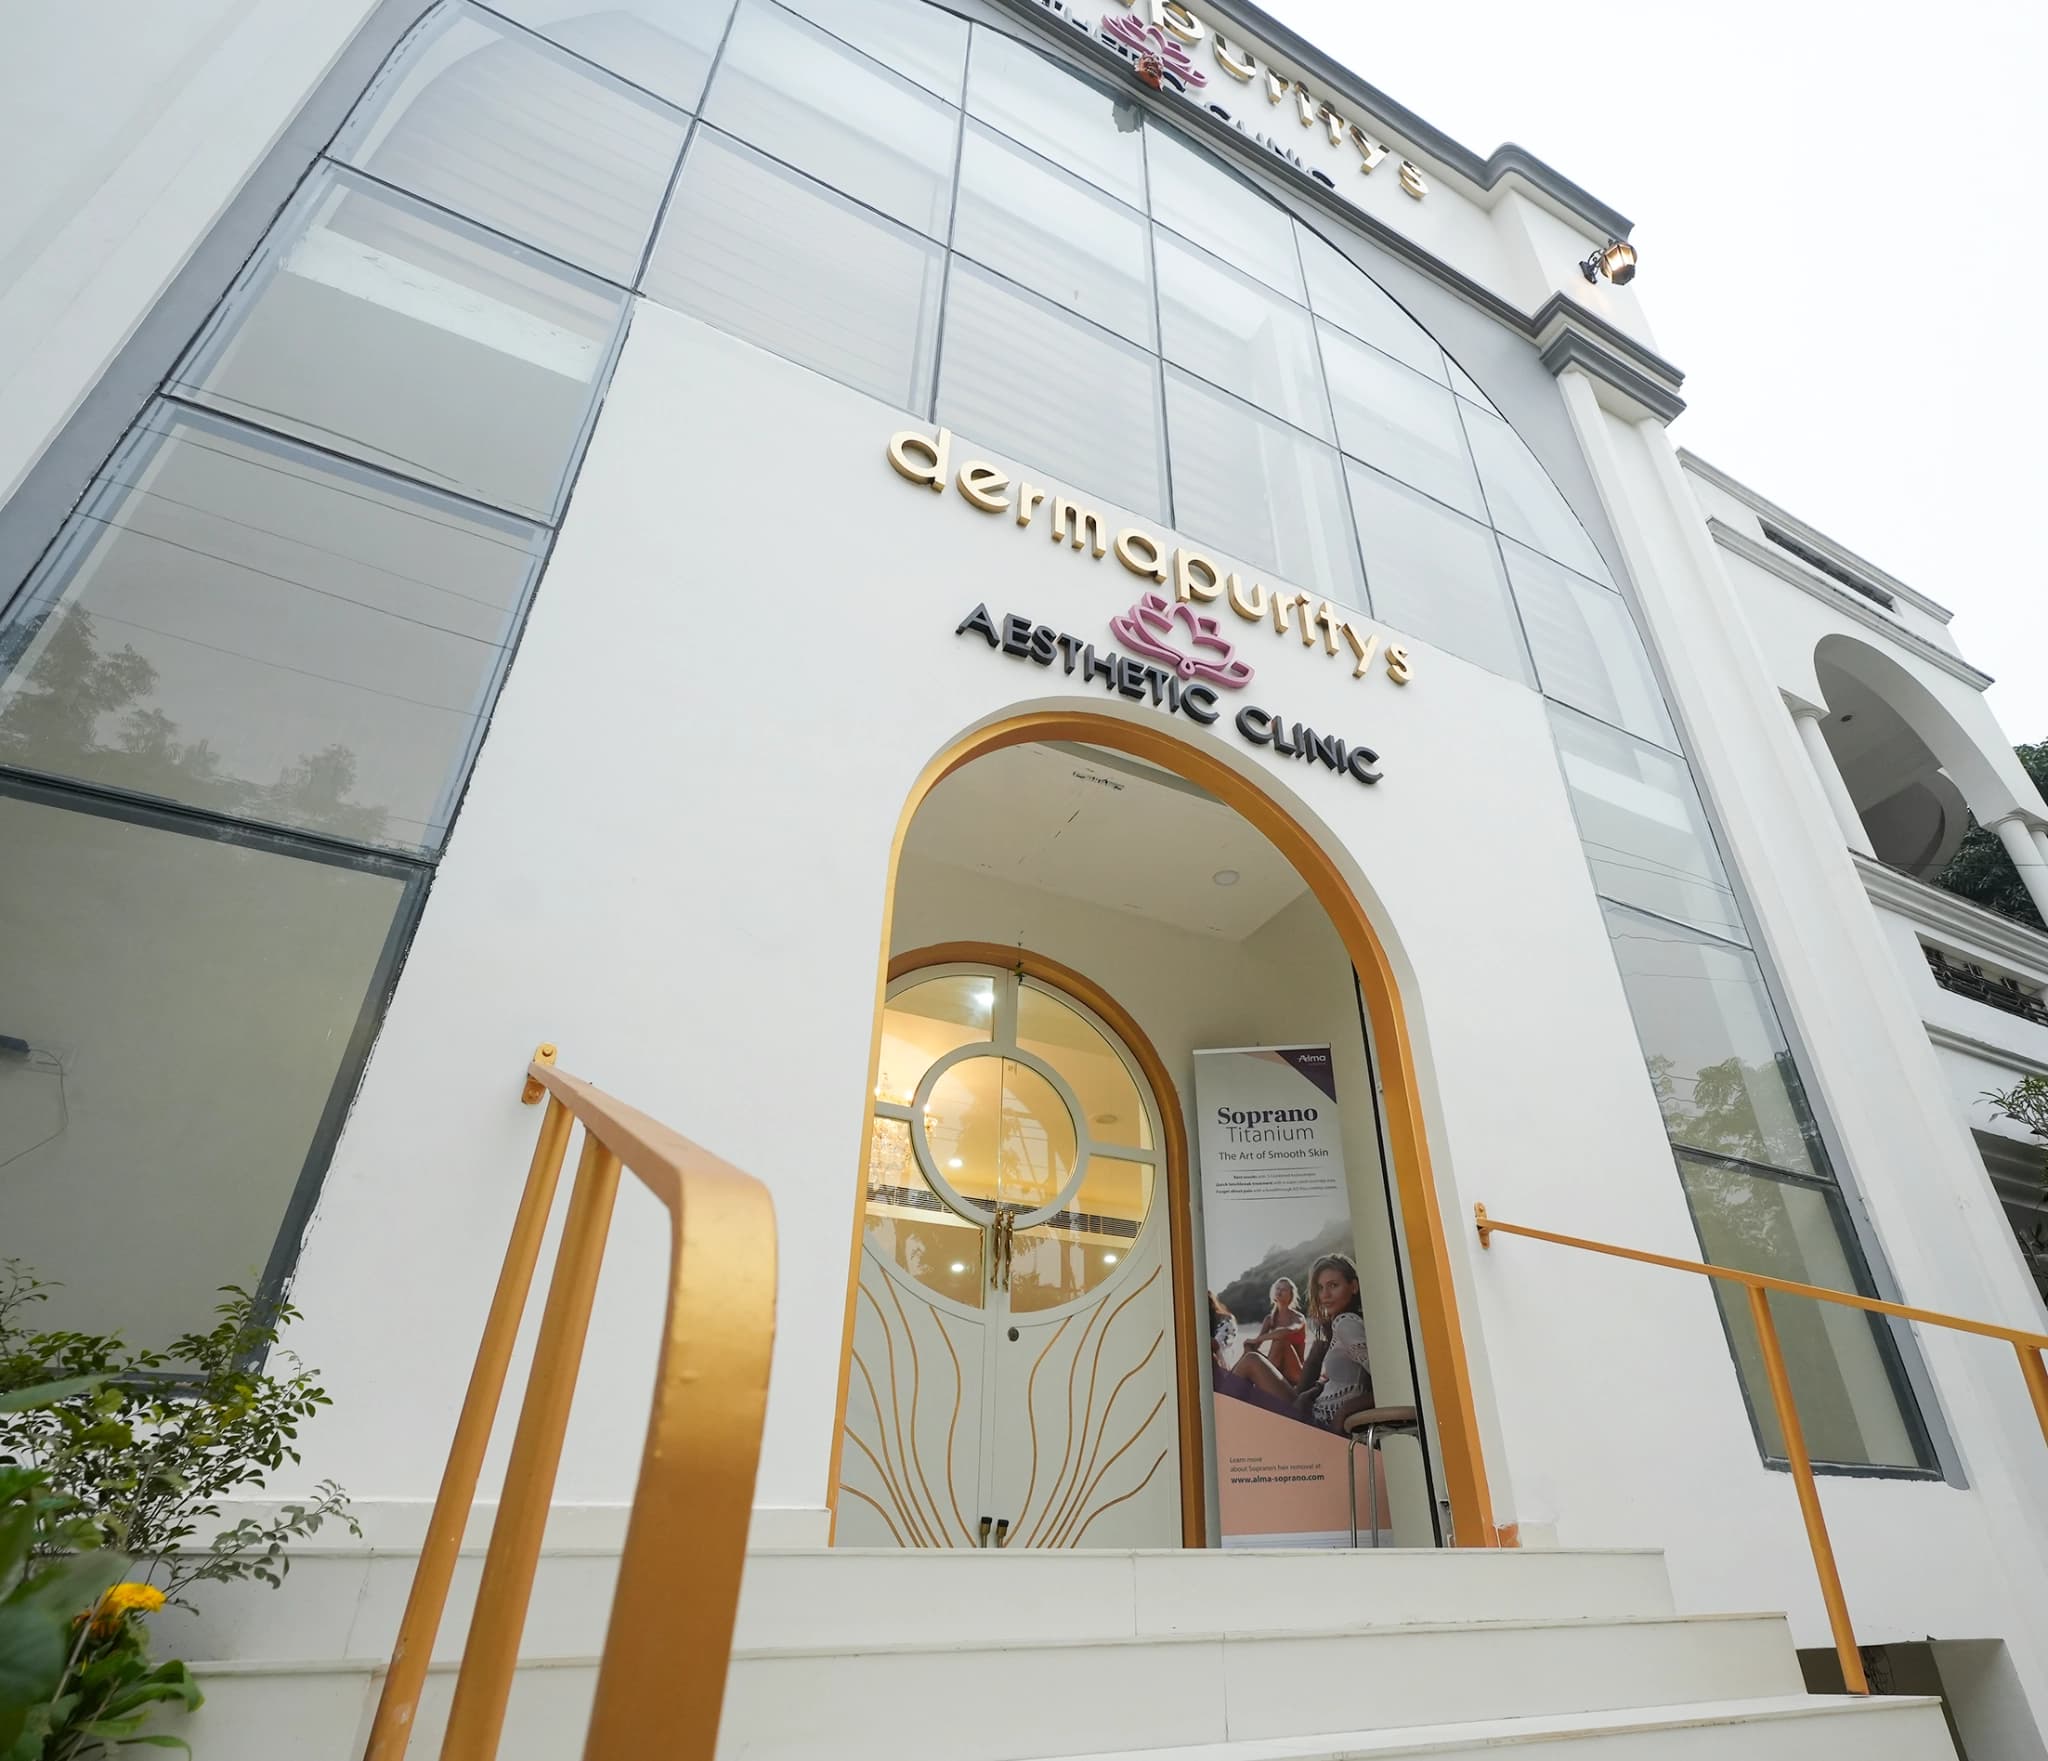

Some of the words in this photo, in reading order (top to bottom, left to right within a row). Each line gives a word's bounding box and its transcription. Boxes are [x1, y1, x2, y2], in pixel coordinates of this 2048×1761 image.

[1113, 0, 1430, 200] puritys
[886, 427, 1414, 685] dermapuritys
[955, 602, 1220, 725] AESTHETIC
[1234, 704, 1384, 785] CLINIC
[1217, 1107, 1318, 1128] Soprano
[1226, 1126, 1314, 1143] Titanium
[1219, 1152, 1237, 1161] The
[1239, 1151, 1254, 1160] Art
[1256, 1150, 1266, 1160] of
[1268, 1149, 1306, 1159] Smooth
[1308, 1148, 1329, 1157] Skin
[1231, 1473, 1325, 1485] www.alma-soprano.com
